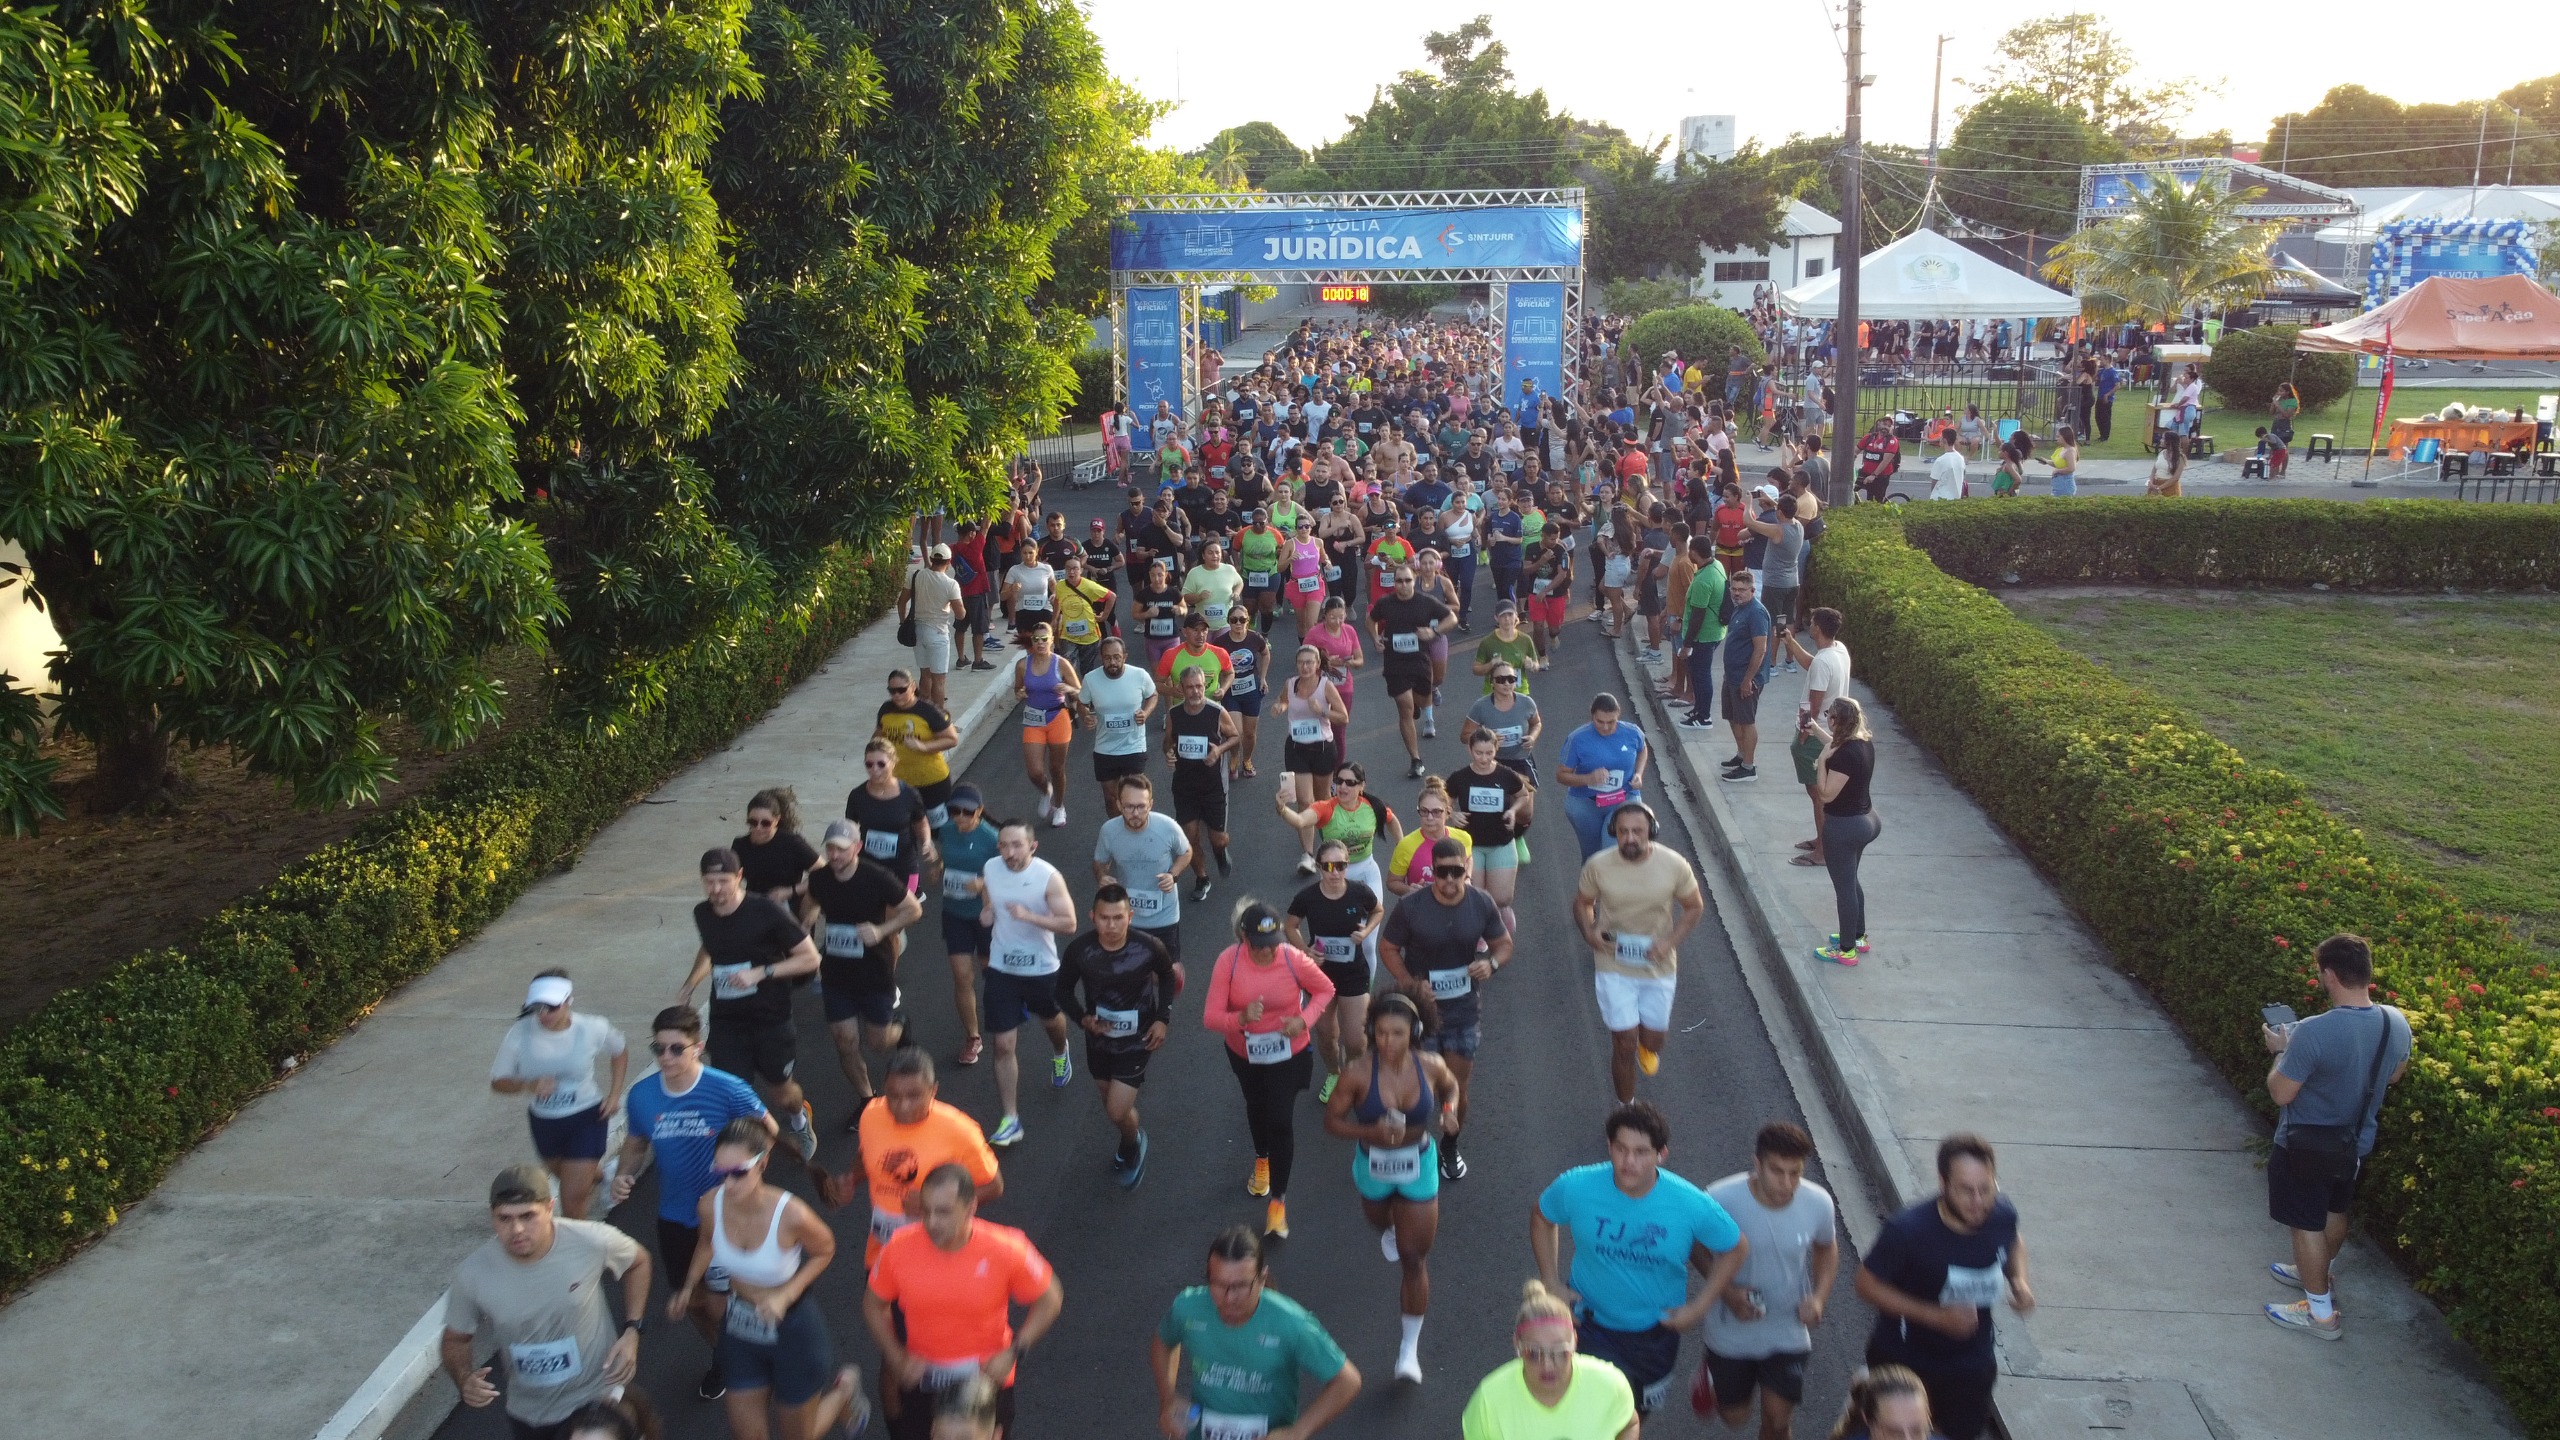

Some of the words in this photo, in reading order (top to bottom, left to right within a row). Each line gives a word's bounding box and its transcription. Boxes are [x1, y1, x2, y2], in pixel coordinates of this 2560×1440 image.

[1325, 218, 1381, 232] VOLTA
[1467, 233, 1514, 242] SINTJURR
[1262, 230, 1424, 261] JURÍDICA
[2448, 271, 2479, 279] VOLTA
[1181, 743, 1201, 752] 0232
